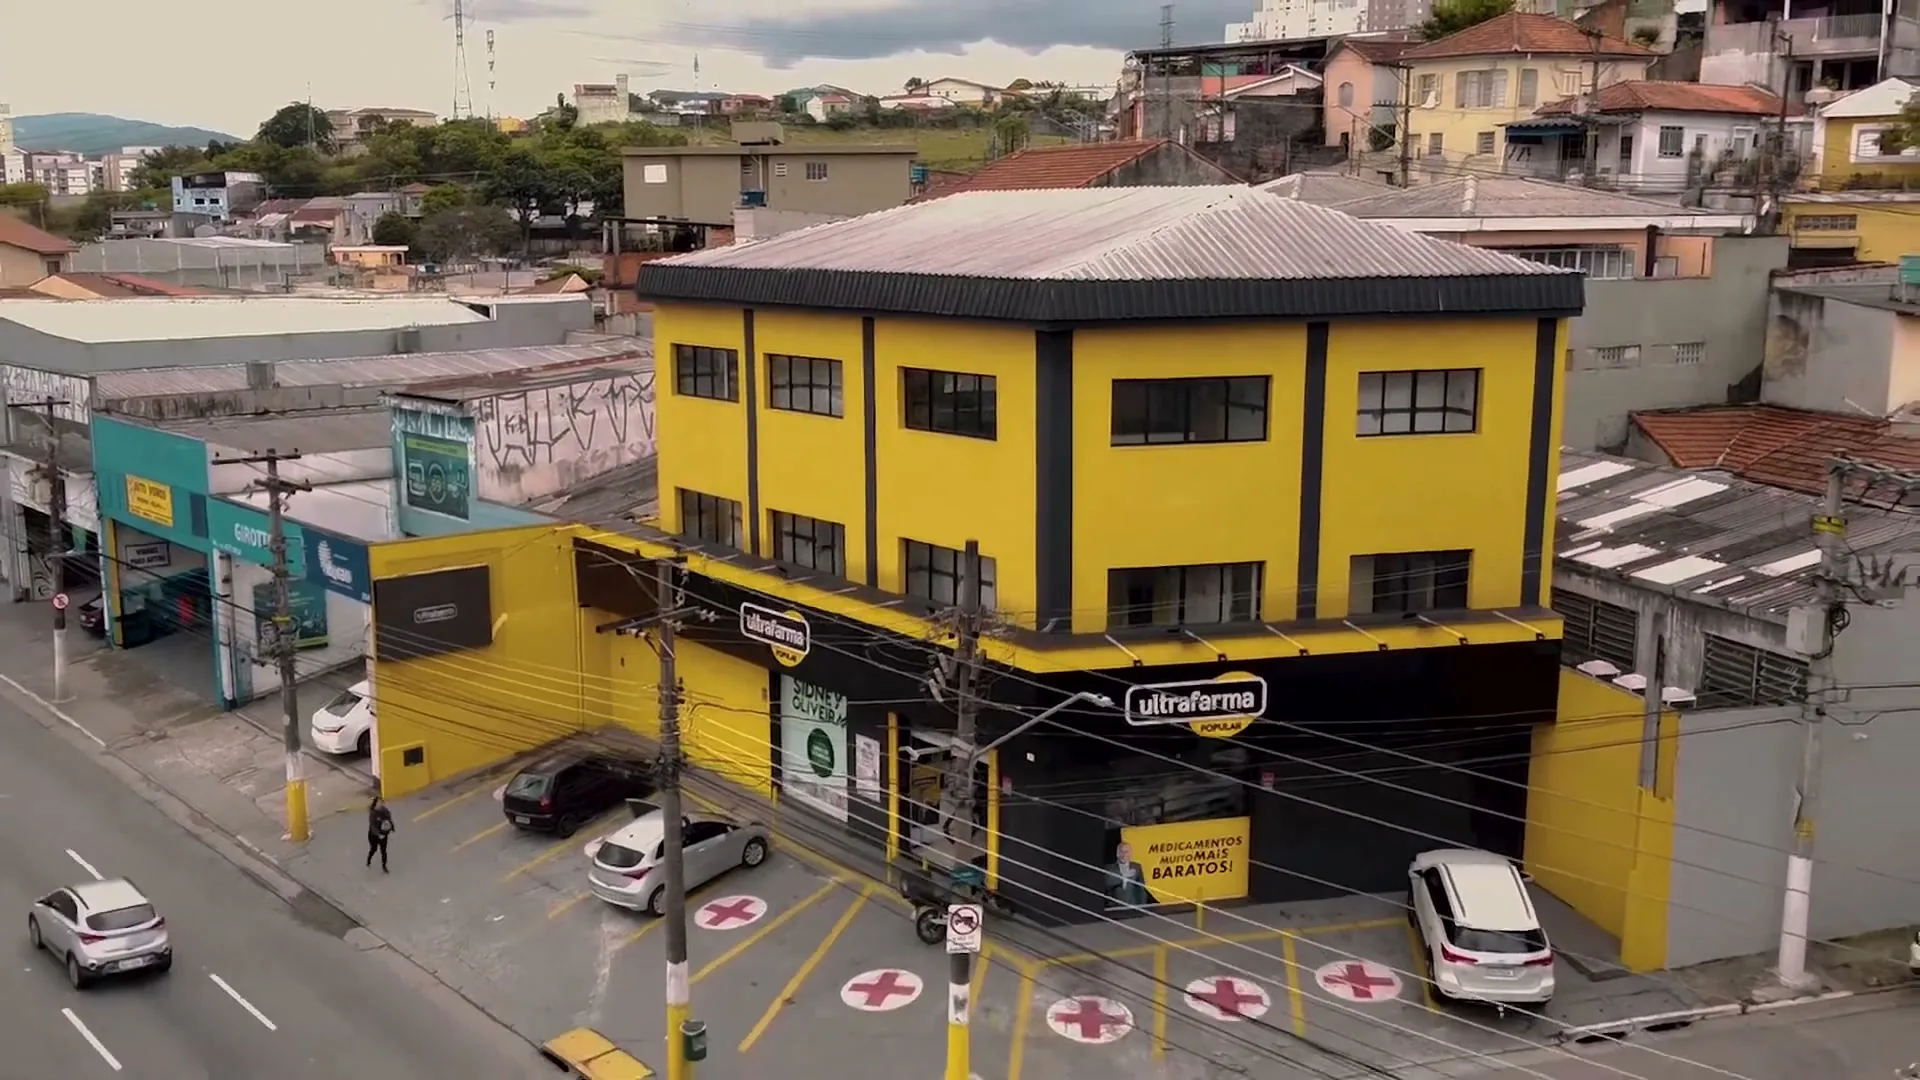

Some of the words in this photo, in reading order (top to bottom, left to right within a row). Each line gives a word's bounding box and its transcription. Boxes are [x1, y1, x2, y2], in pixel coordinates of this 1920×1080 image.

[234, 523, 271, 547] GIROTT
[746, 613, 804, 646] ultrafarma
[793, 677, 843, 709] SIDNEY
[1139, 691, 1255, 715] ultrafarma
[1200, 722, 1242, 733] POPULAR
[1148, 836, 1243, 854] MEDICAMENTOS
[1152, 860, 1233, 880] BARATOS!
